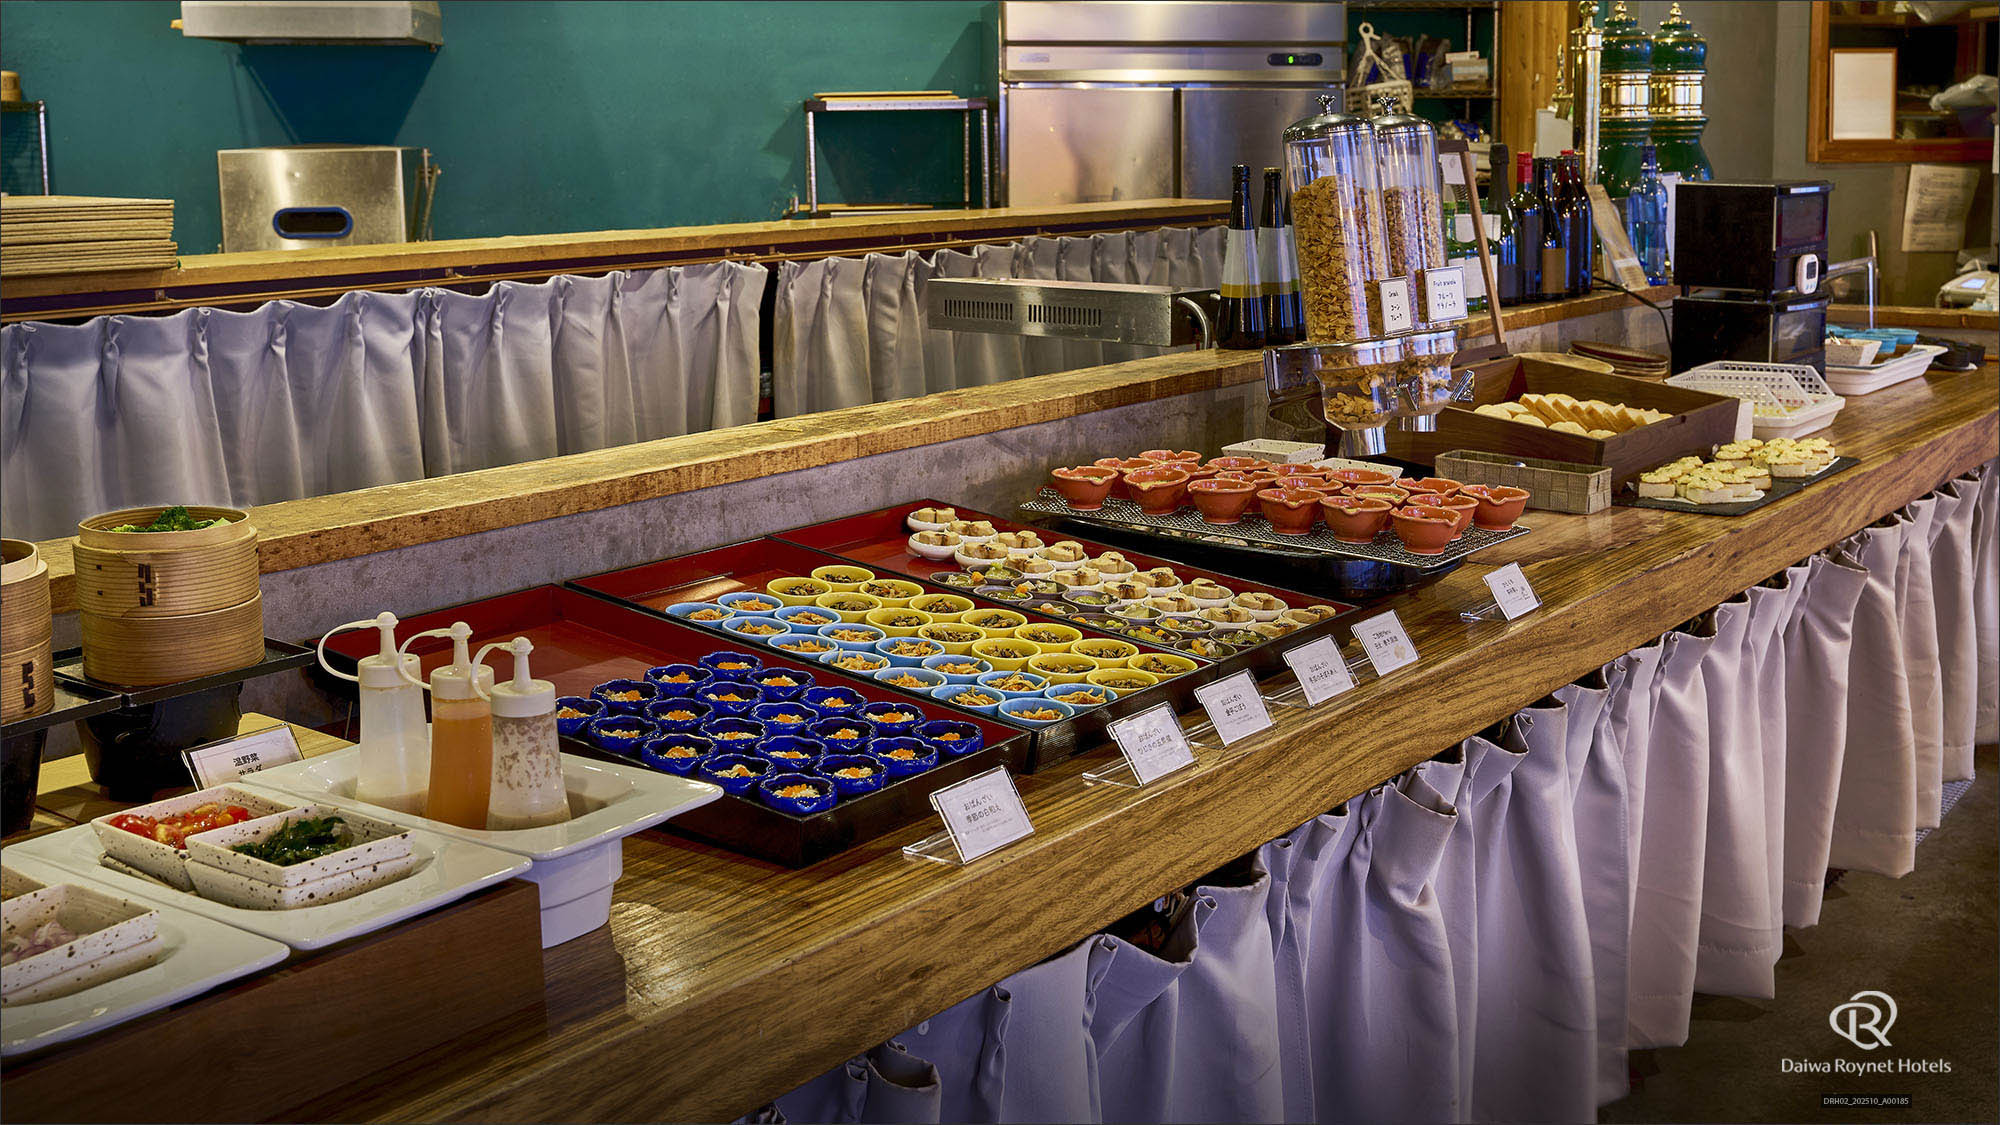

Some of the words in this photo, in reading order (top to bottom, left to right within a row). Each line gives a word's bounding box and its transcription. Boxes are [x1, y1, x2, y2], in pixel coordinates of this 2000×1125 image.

[233, 752, 260, 767] 温野菜
[963, 793, 993, 811] おばんざい
